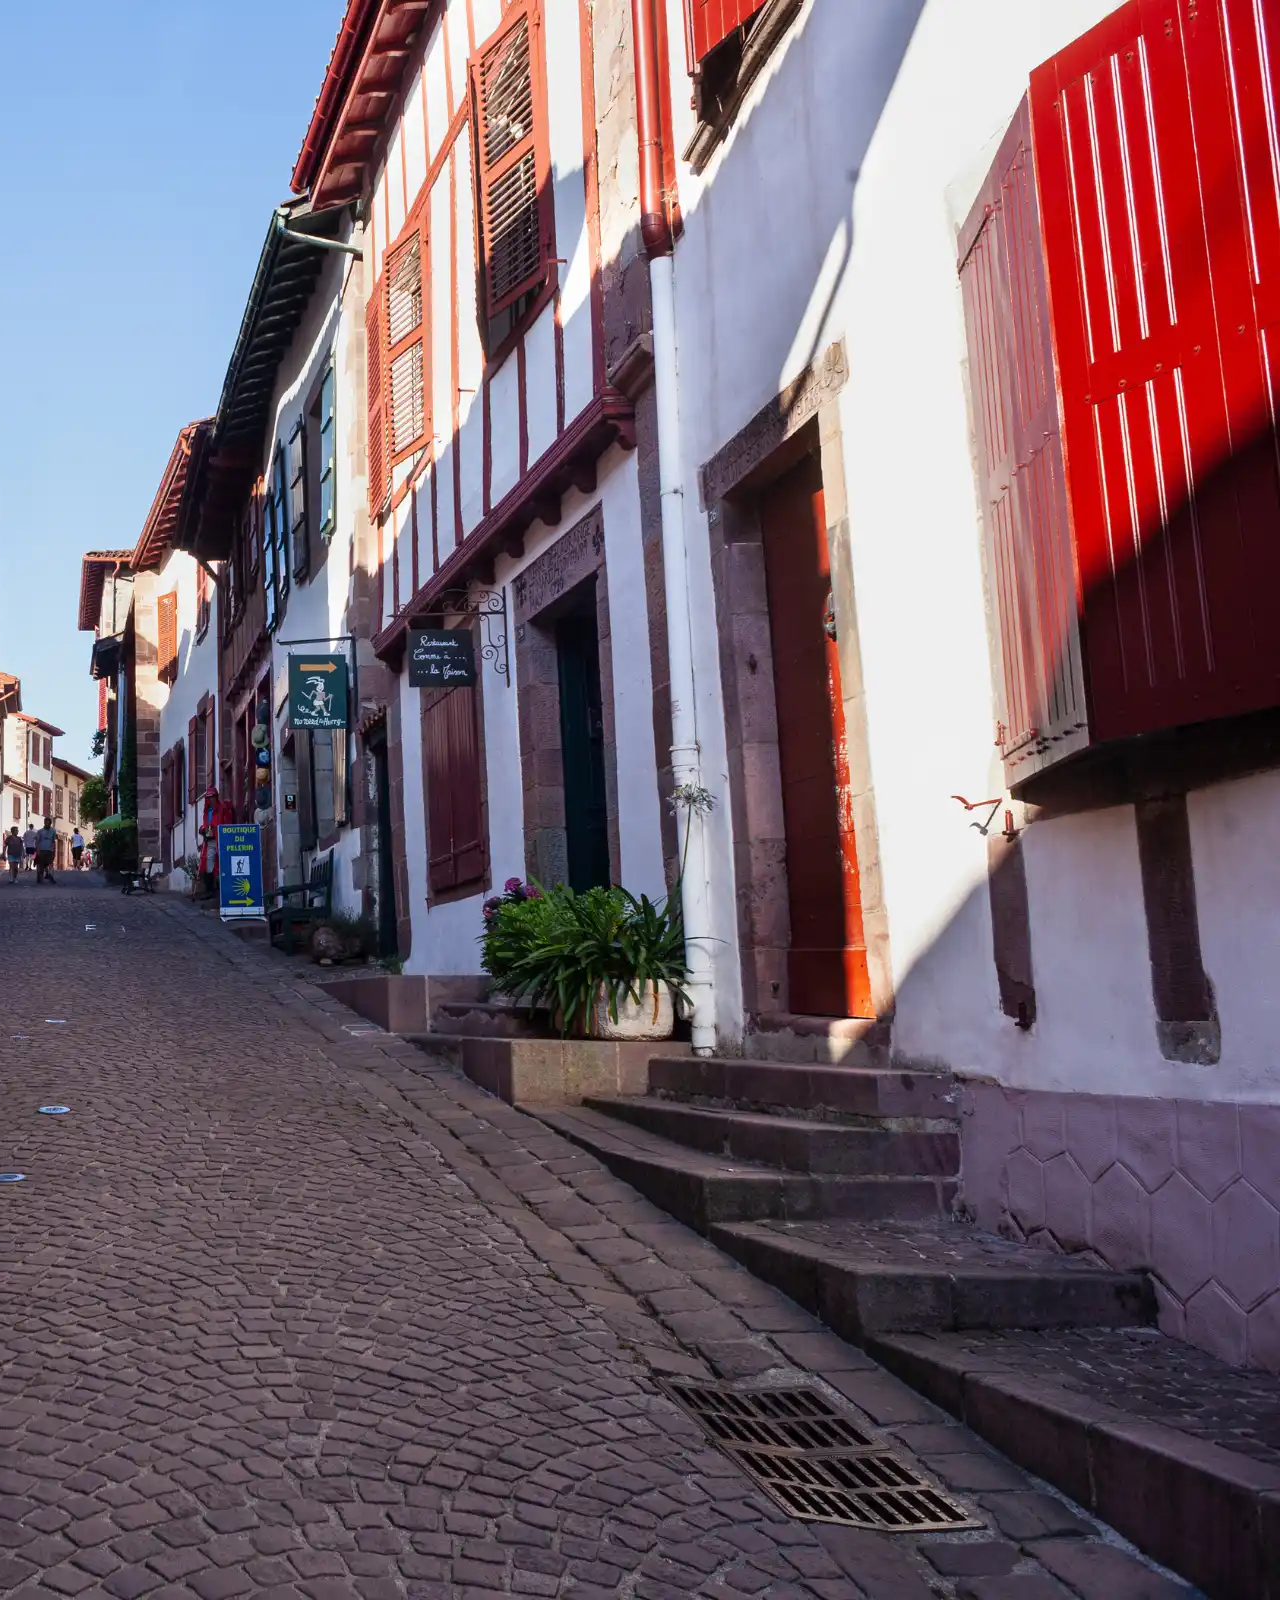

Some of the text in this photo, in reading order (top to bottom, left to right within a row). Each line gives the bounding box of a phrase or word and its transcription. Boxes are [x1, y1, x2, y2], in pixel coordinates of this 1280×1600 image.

[420, 635, 458, 646] Restaurant
[413, 648, 441, 660] Comme
[442, 664, 468, 680] Maison
